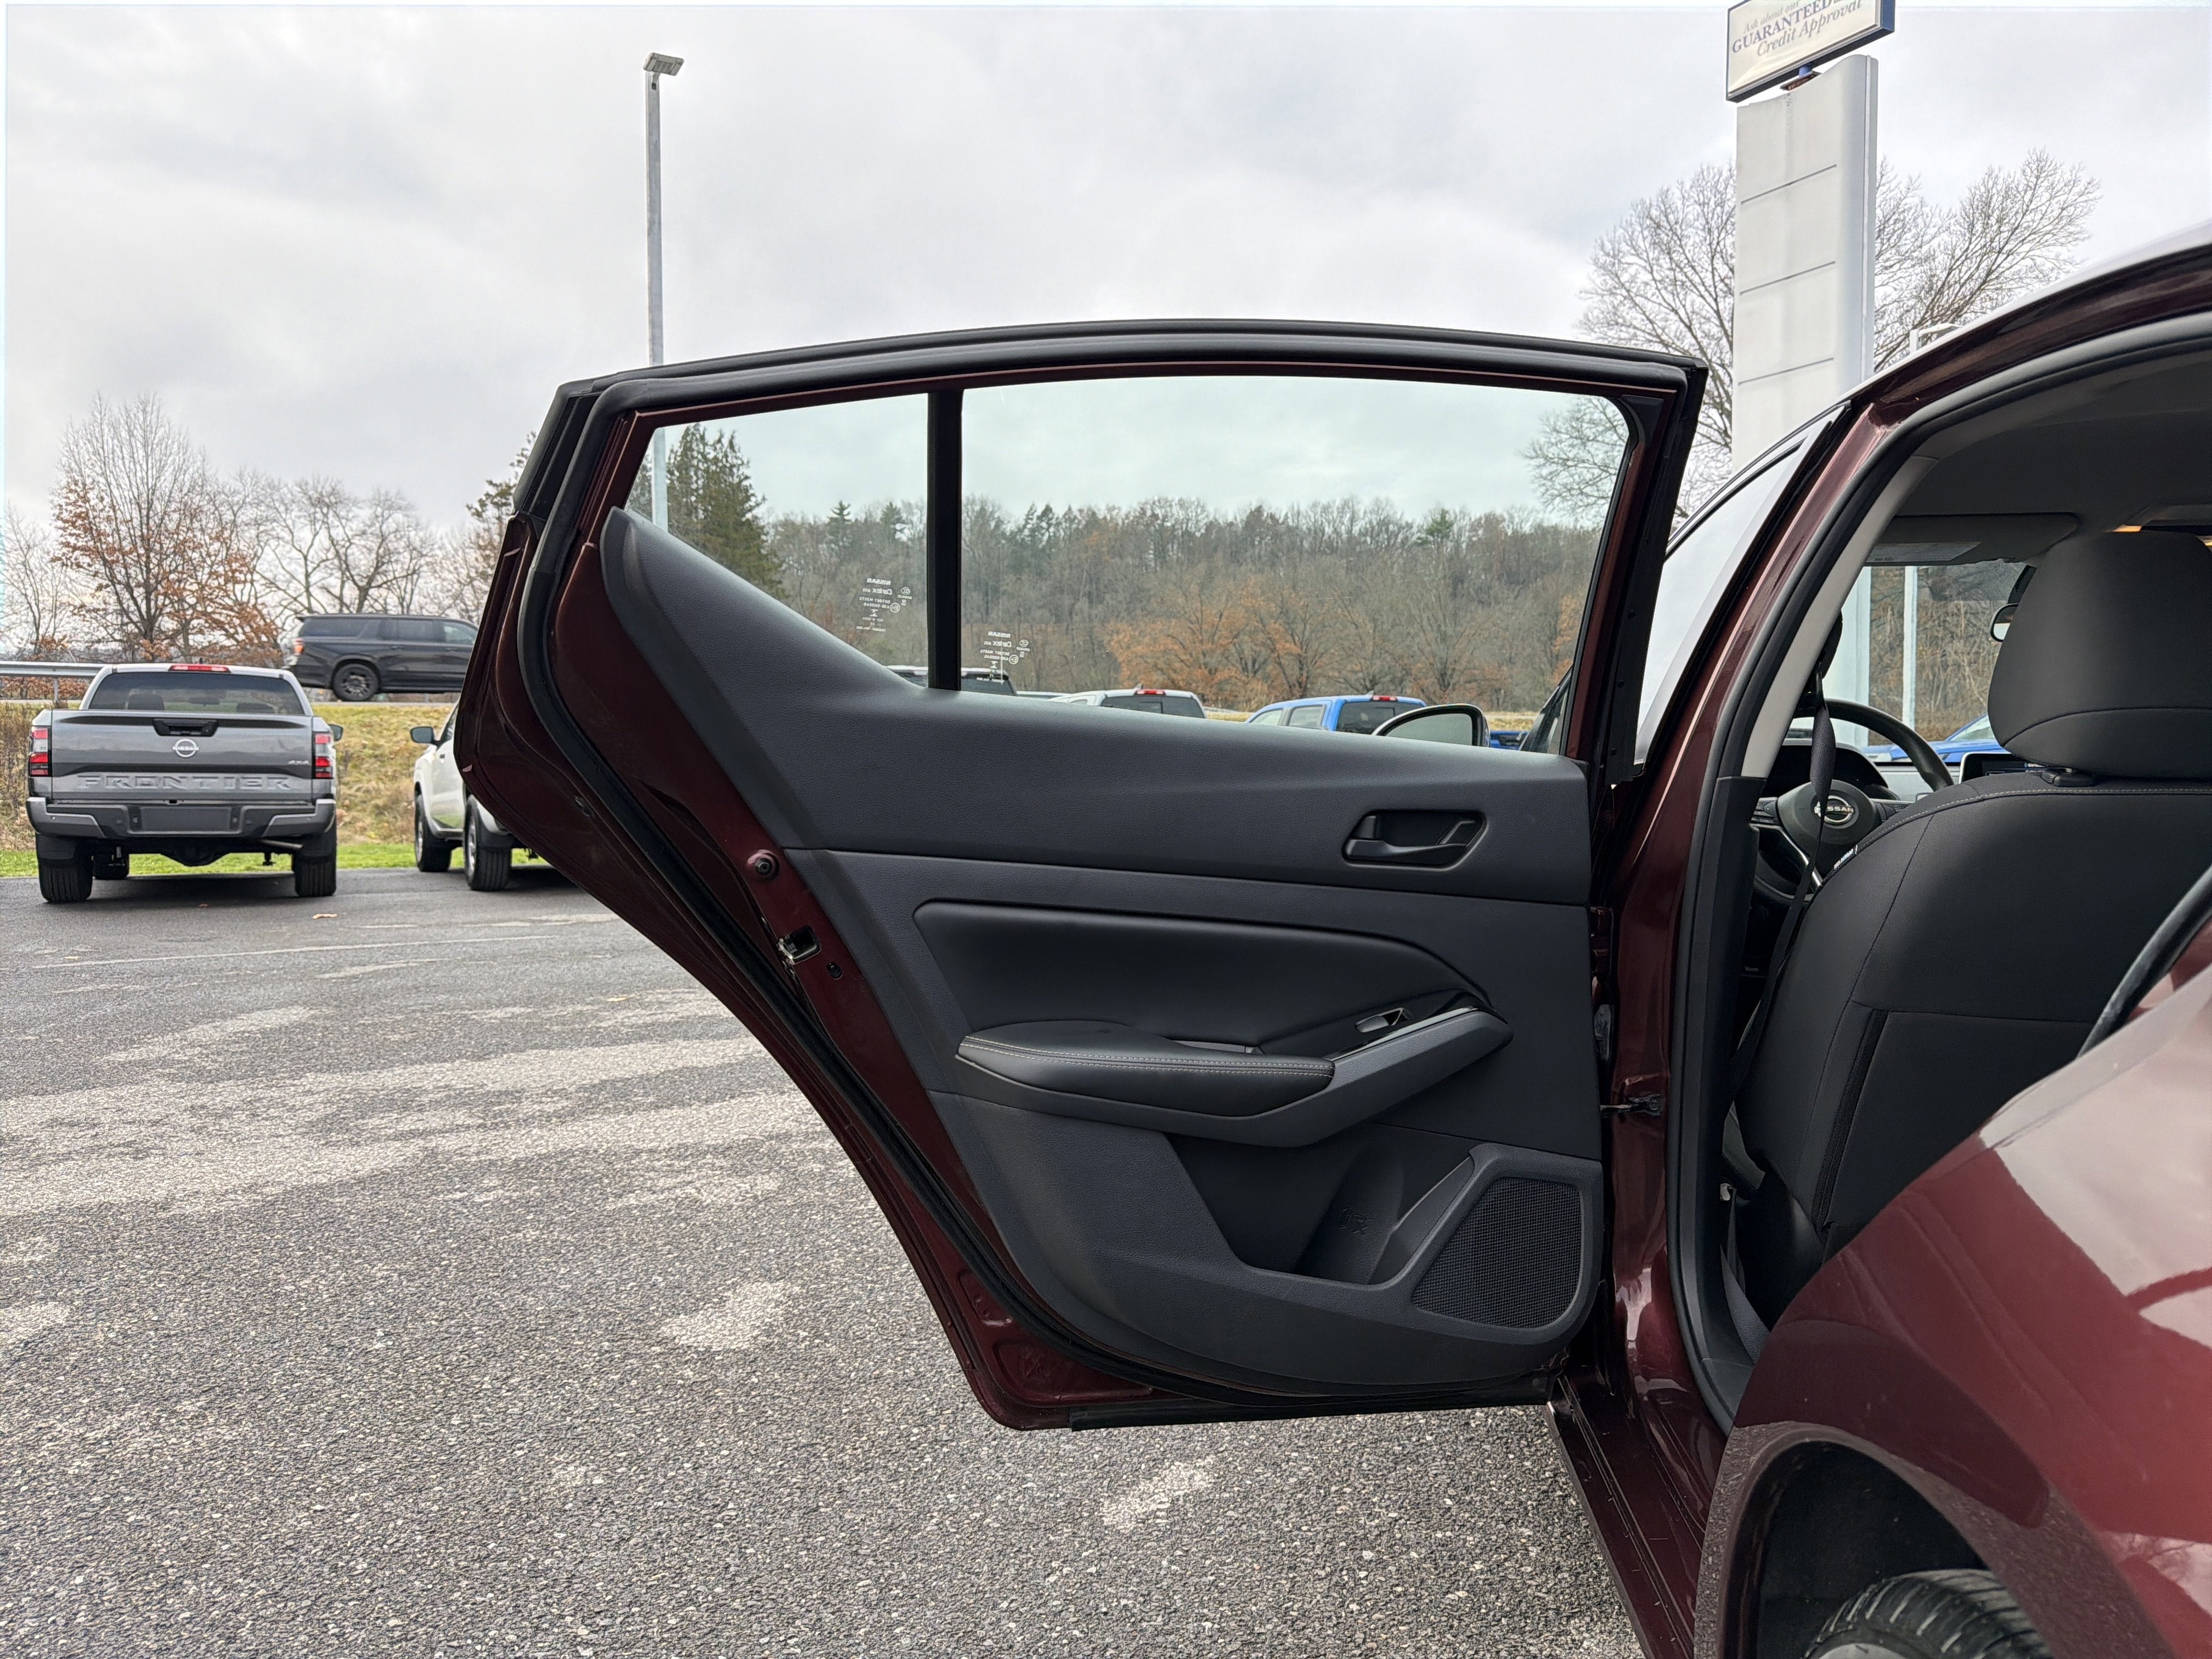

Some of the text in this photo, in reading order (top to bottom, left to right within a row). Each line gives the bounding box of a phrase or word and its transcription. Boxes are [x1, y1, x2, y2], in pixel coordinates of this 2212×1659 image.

[1732, 0, 1832, 53] GUARANTEED
[1743, 1, 1800, 33] Ask about our
[1757, 0, 1863, 56] Credit Approval
[77, 775, 291, 790] FRONTIER
